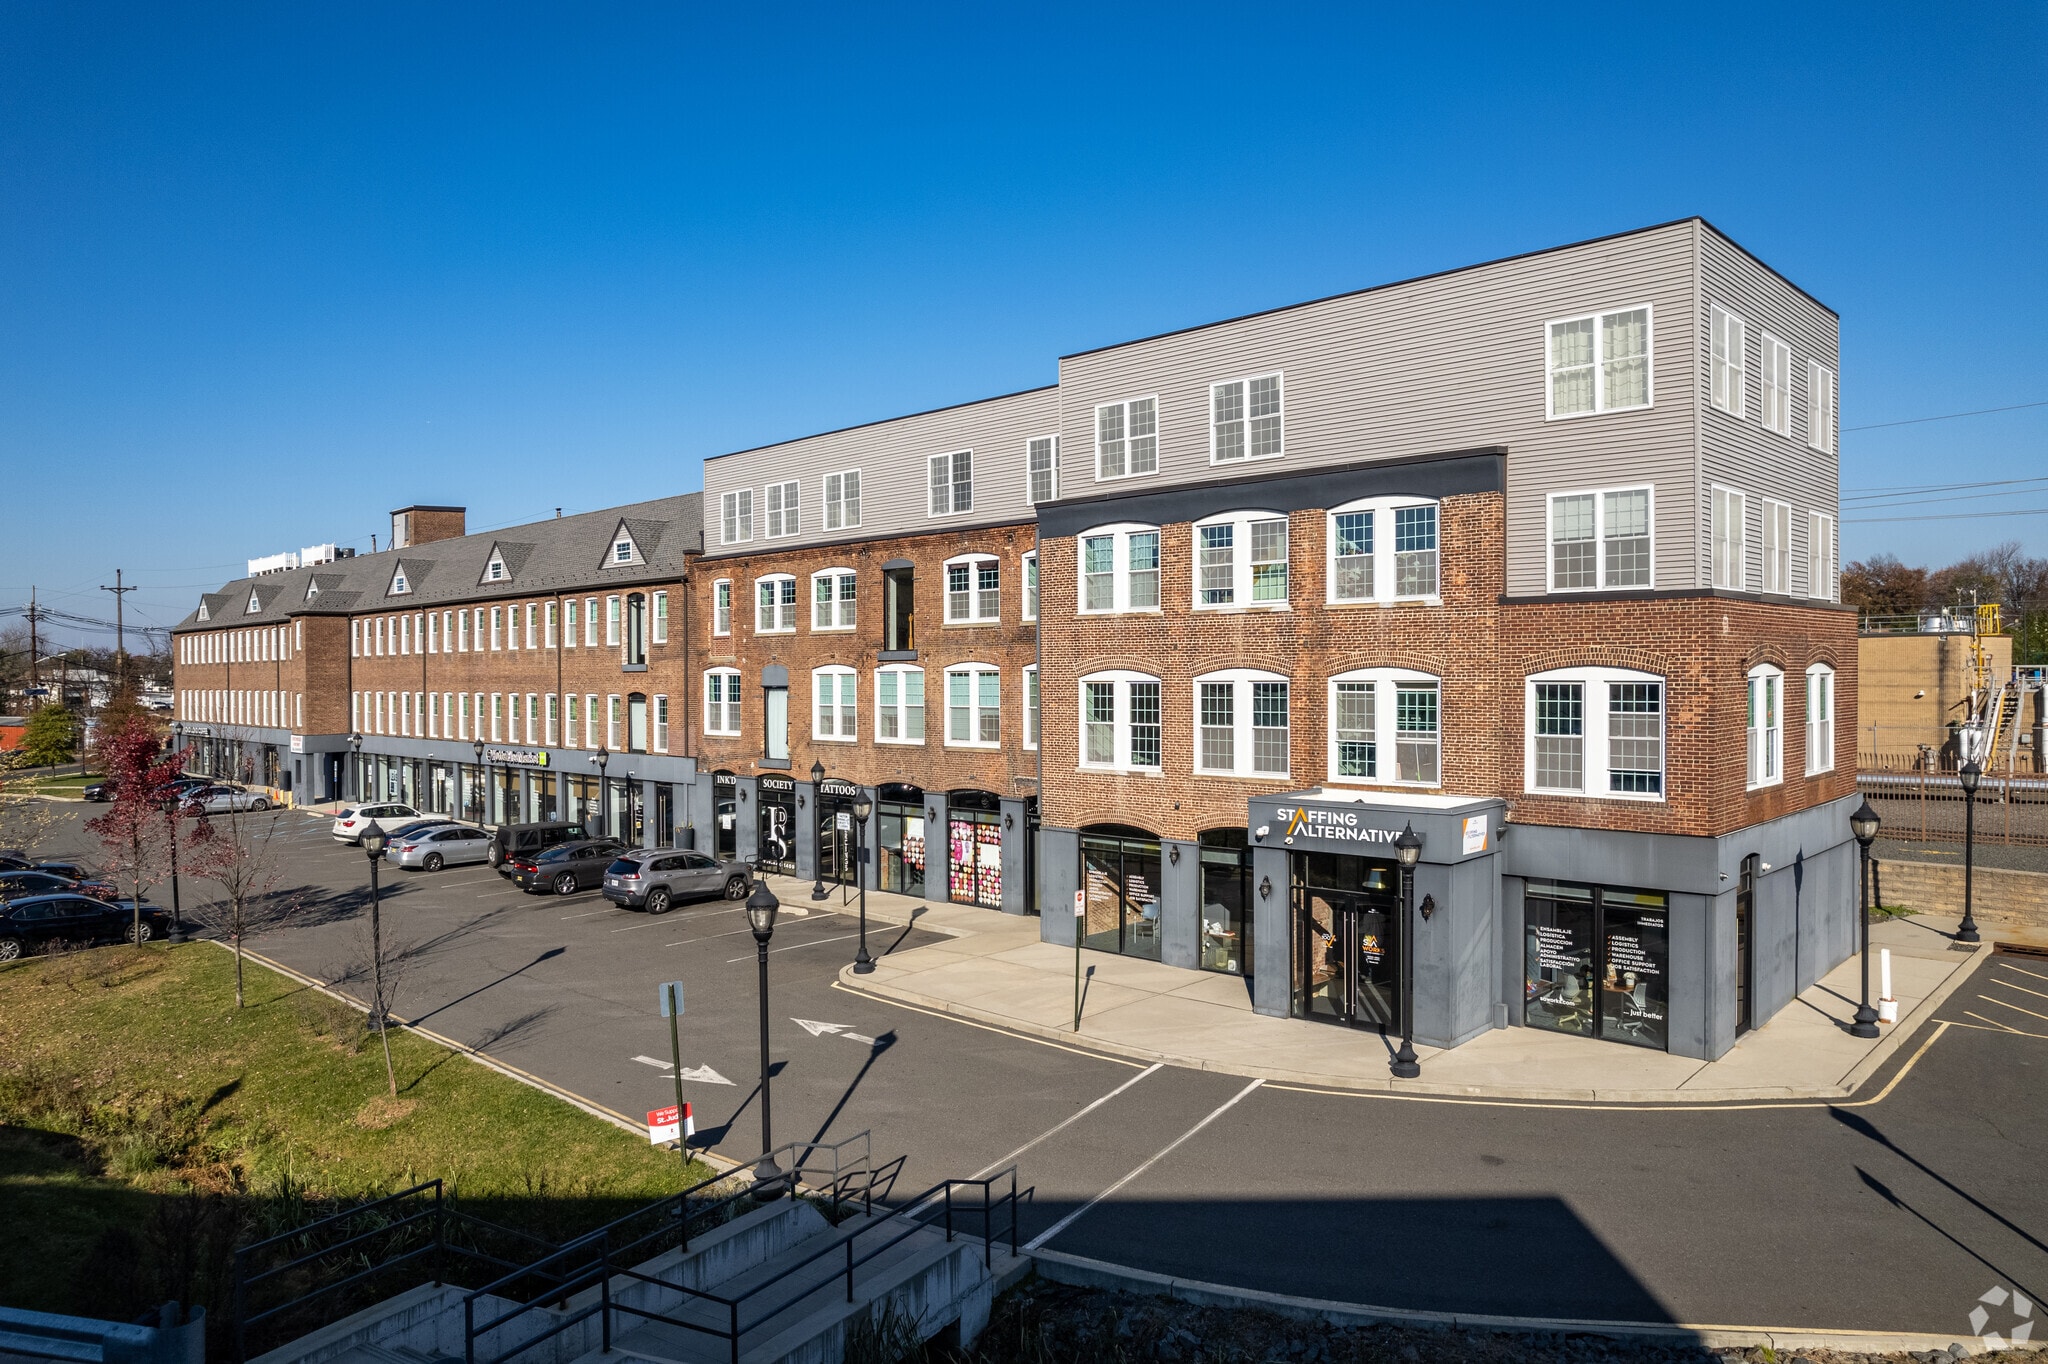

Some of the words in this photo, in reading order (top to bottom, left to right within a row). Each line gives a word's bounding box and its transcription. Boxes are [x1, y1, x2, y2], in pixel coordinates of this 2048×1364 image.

[717, 775, 737, 785] INK'D
[763, 779, 793, 790] SOCIETY
[820, 784, 856, 796] TATTOOS
[1277, 806, 1358, 832] STAFFING
[1293, 820, 1416, 843] ALTERNATIVE
[1611, 935, 1639, 943] ASSEMBLY
[1611, 941, 1639, 949] LOGISTICS
[1611, 946, 1646, 955] PRODUCTION
[1611, 952, 1644, 961] WAREHOUSE
[1623, 965, 1660, 975] SATISFACTION
[1630, 1009, 1642, 1017] just
[1642, 1011, 1663, 1021] better
[667, 1113, 679, 1122] Jud
